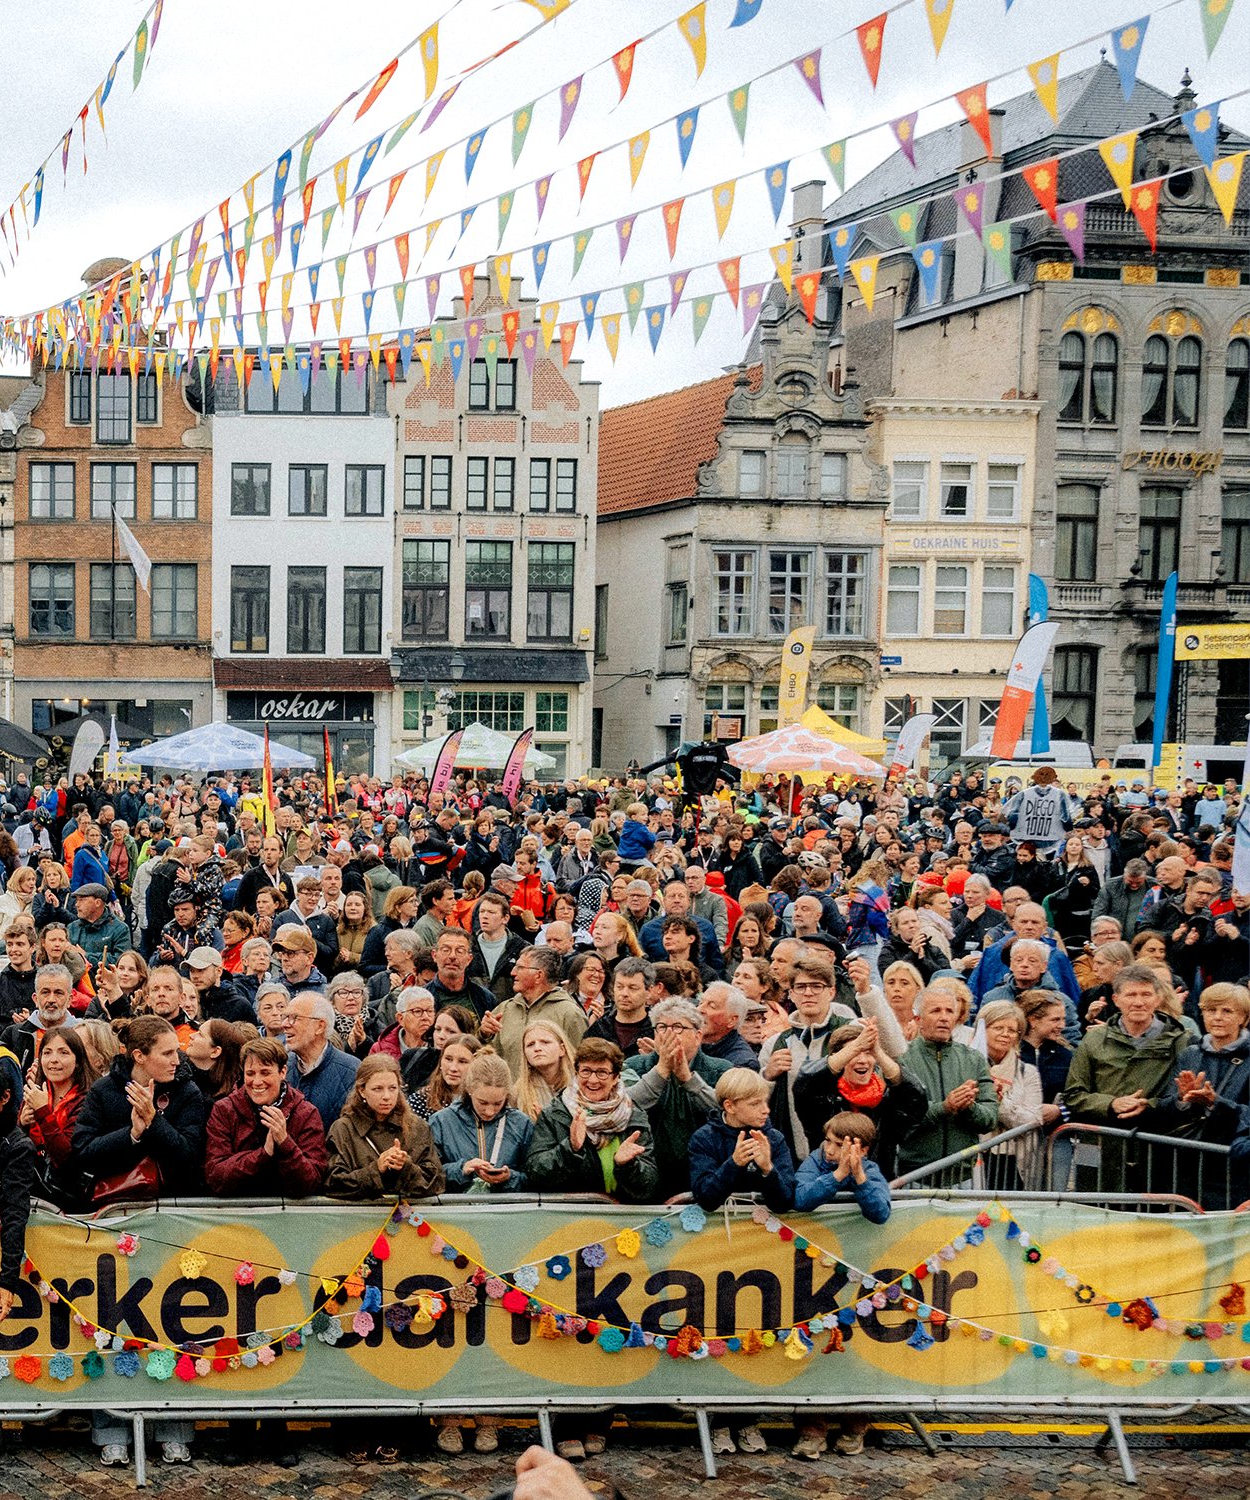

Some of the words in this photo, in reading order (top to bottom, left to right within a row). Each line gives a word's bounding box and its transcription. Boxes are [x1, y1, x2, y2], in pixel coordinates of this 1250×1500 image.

[913, 538, 967, 549] OEKRAINE
[972, 538, 999, 549] HUIS
[787, 673, 797, 698] EHBO
[260, 692, 339, 719] oskar
[1025, 799, 1055, 817] DIEGO
[1024, 816, 1052, 837] 1000
[313, 1252, 531, 1349] dan
[575, 1247, 979, 1344] kanker
